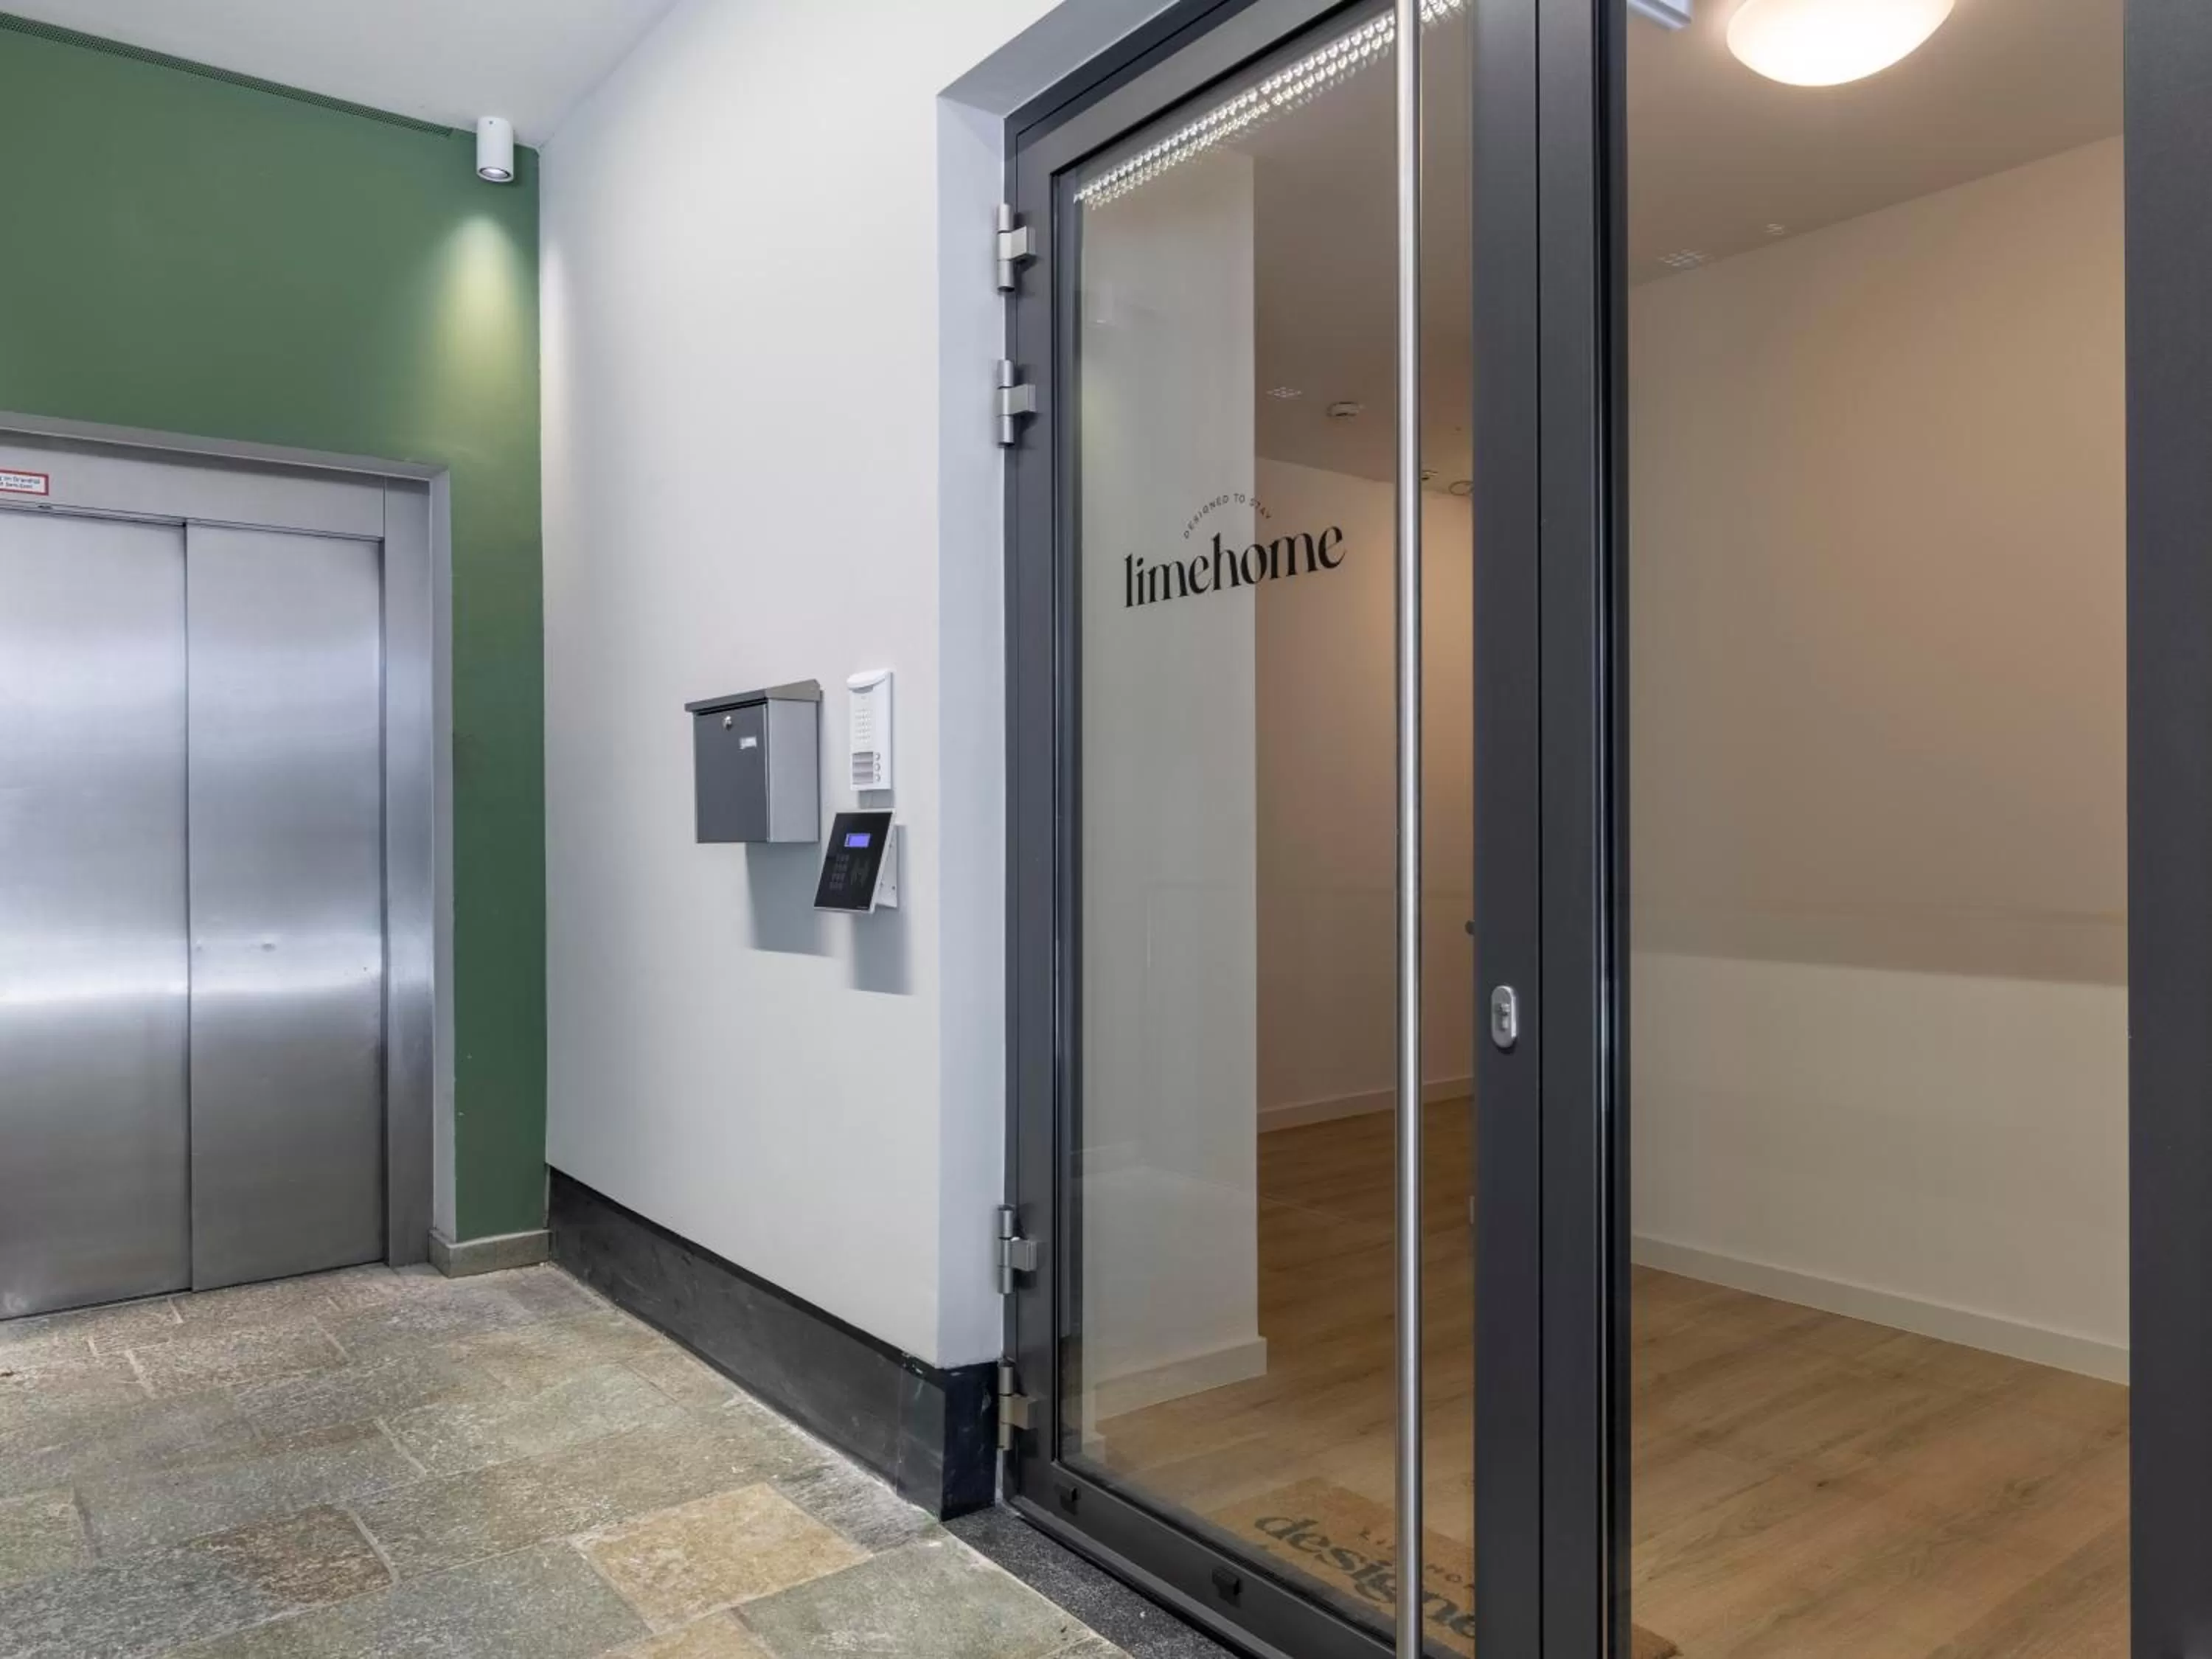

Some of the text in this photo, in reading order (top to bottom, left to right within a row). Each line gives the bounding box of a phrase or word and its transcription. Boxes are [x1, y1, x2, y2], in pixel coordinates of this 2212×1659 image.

[1183, 494, 1229, 539] DESIGNED
[1234, 493, 1245, 504] TO
[1124, 526, 1346, 608] limehome
